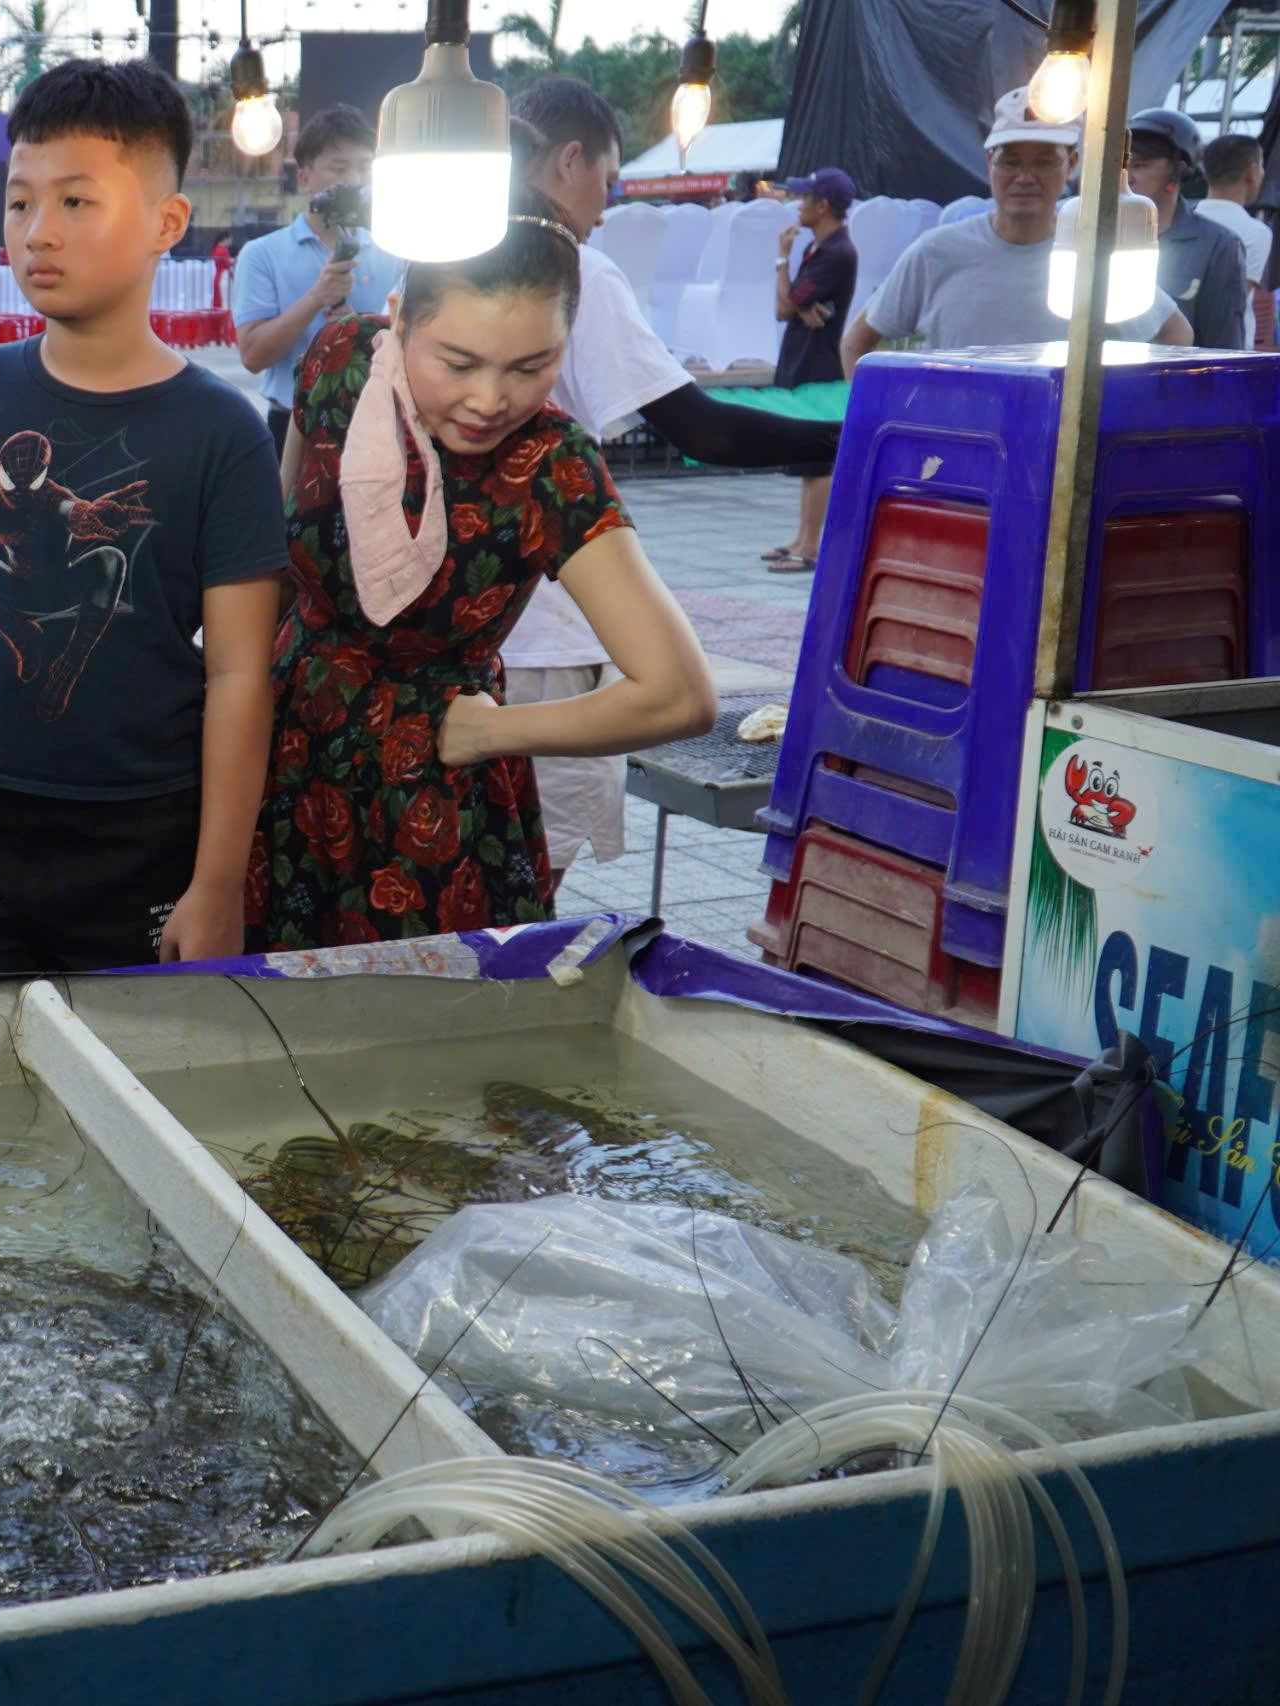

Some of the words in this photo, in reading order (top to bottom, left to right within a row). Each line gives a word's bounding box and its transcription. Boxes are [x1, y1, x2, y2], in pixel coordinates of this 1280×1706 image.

[1089, 839, 1111, 856] CAM
[1112, 847, 1140, 864] RANH
[150, 904, 163, 914] MAY
[1095, 930, 1280, 1240] SEAF
